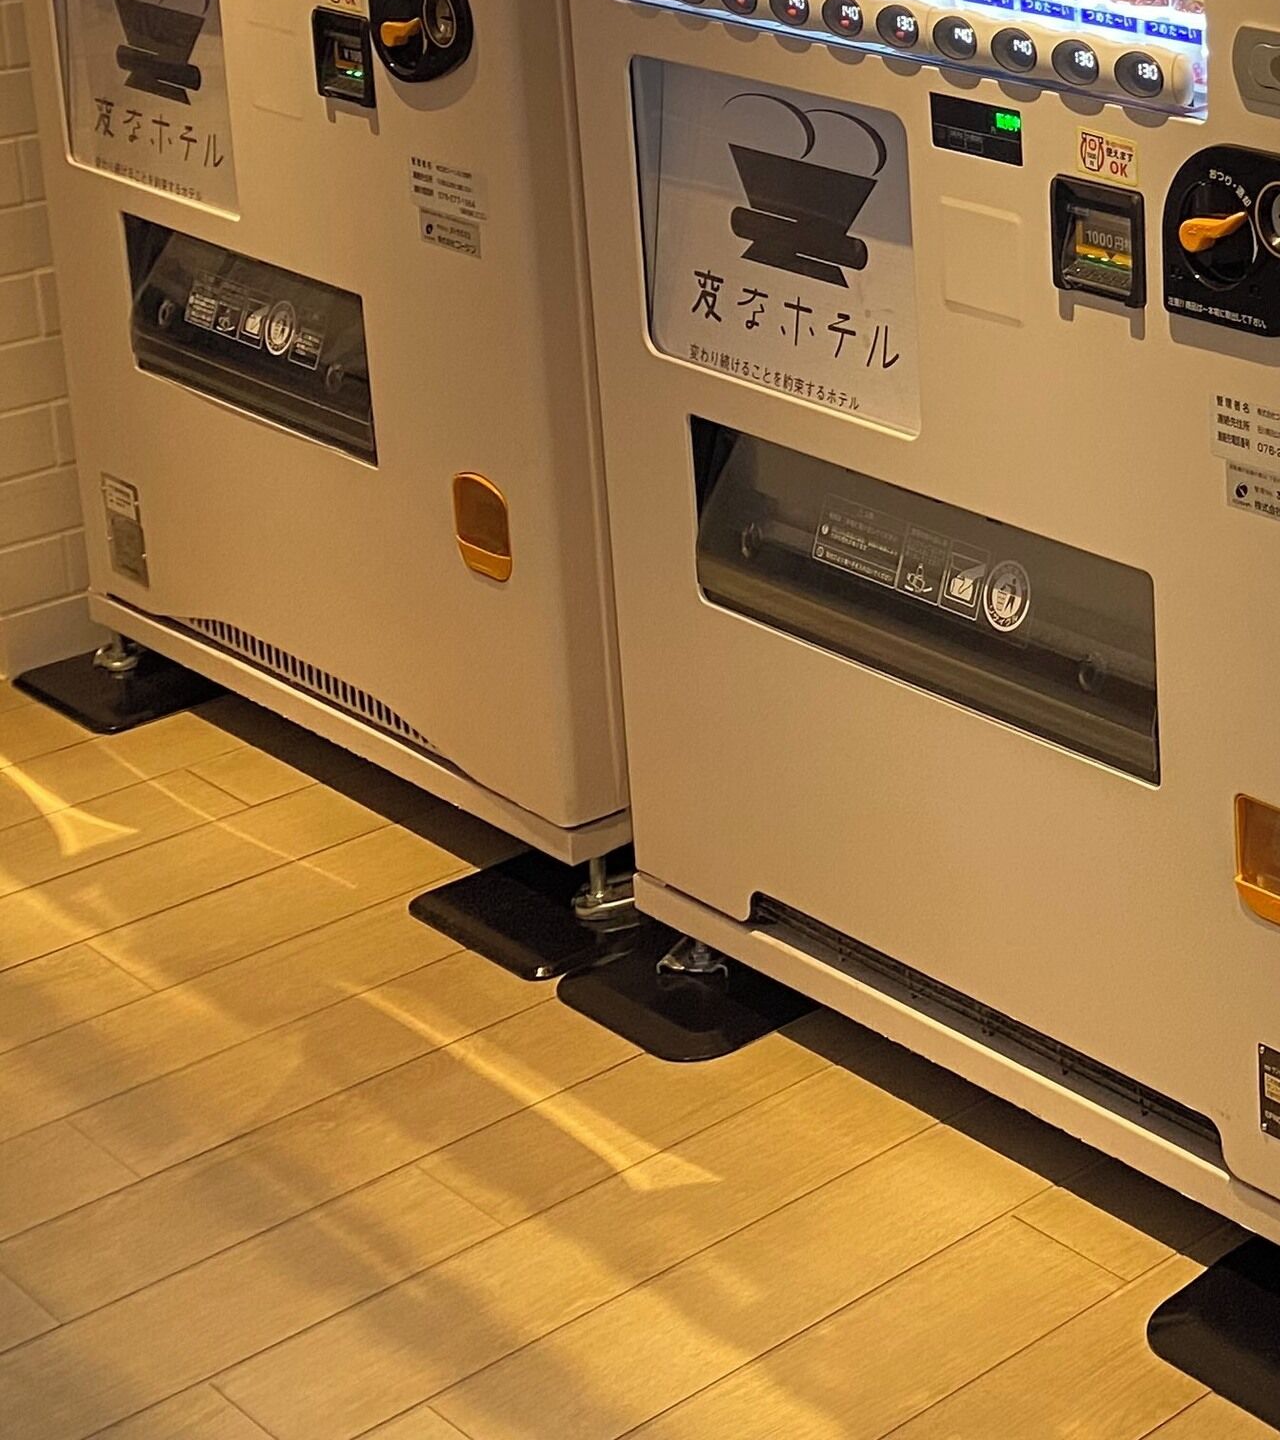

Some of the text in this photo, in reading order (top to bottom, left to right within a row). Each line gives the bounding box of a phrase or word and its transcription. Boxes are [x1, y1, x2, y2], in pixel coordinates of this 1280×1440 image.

[95, 97, 224, 169] 変なホテル
[1109, 161, 1128, 178] OK
[693, 269, 900, 370] 変なホテル
[688, 343, 860, 411] 変わり続けることを約束するホテル
